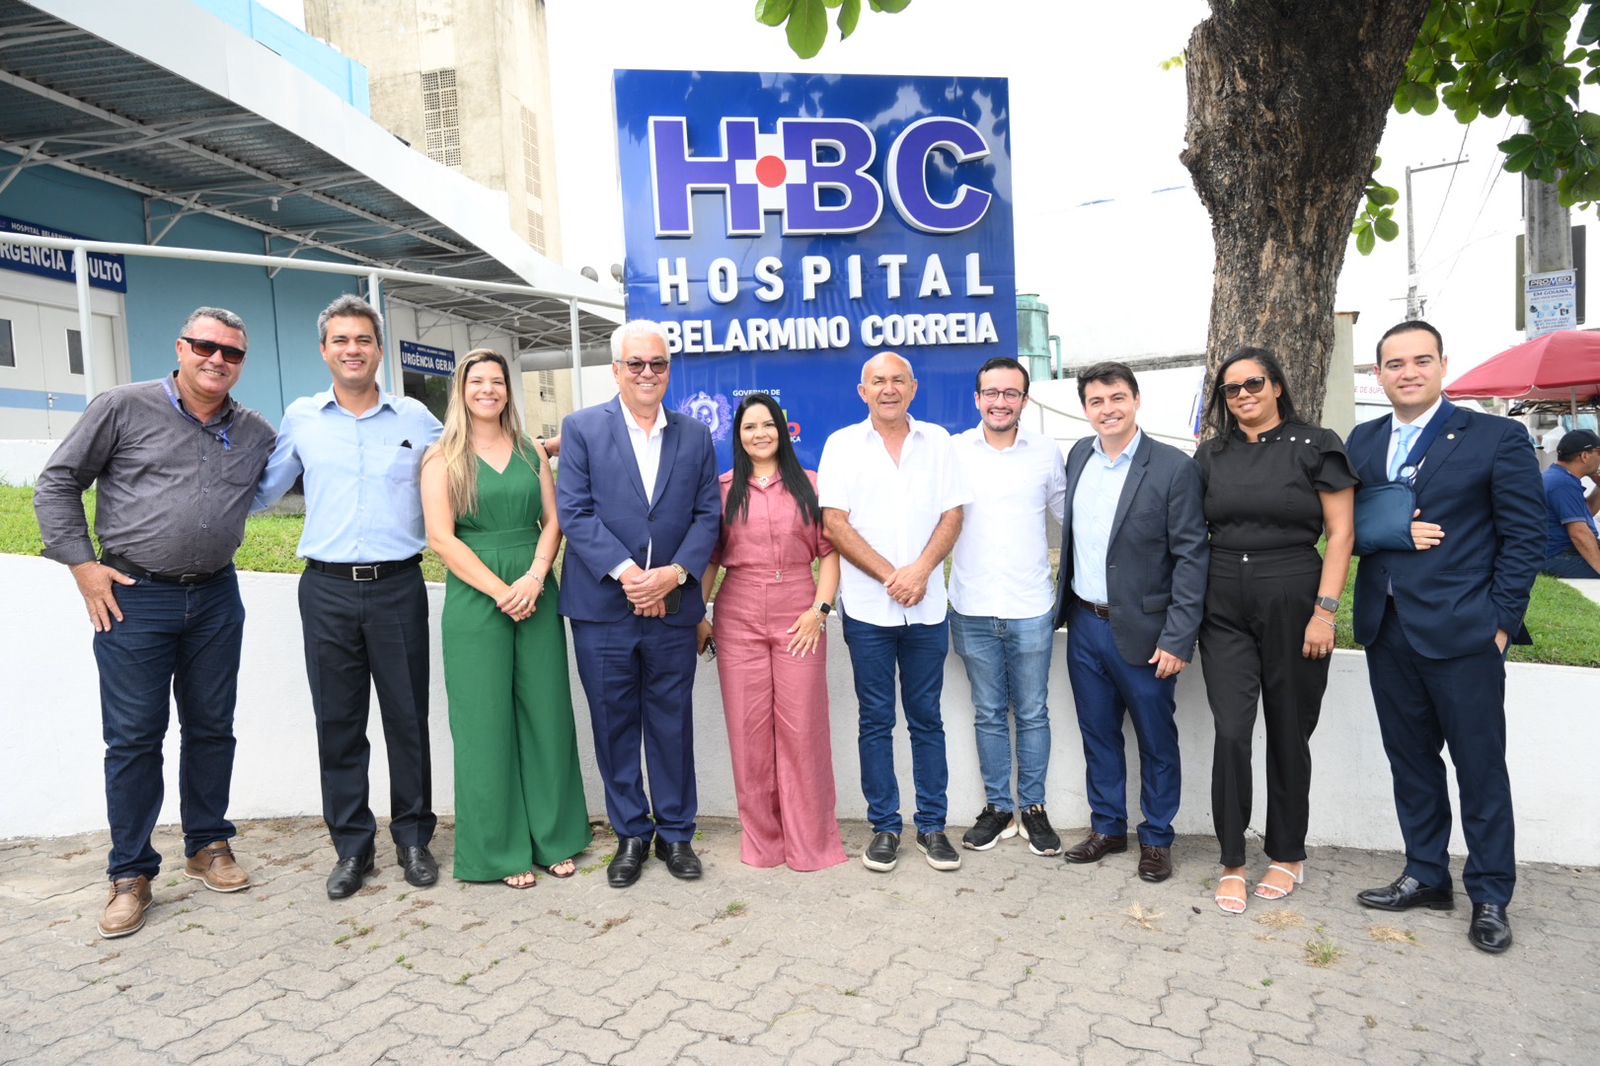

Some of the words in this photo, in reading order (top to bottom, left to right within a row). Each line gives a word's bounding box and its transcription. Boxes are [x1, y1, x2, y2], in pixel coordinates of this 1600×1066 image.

[648, 116, 992, 237] HBC
[11, 222, 40, 235] HOSPITAL
[71, 253, 122, 282] ULTO
[657, 253, 994, 304] HOSPITAL
[661, 315, 850, 354] BELARMINO
[861, 312, 998, 347] CORREIA
[402, 351, 434, 368] URGÊNCIA
[435, 358, 455, 372] GERAL
